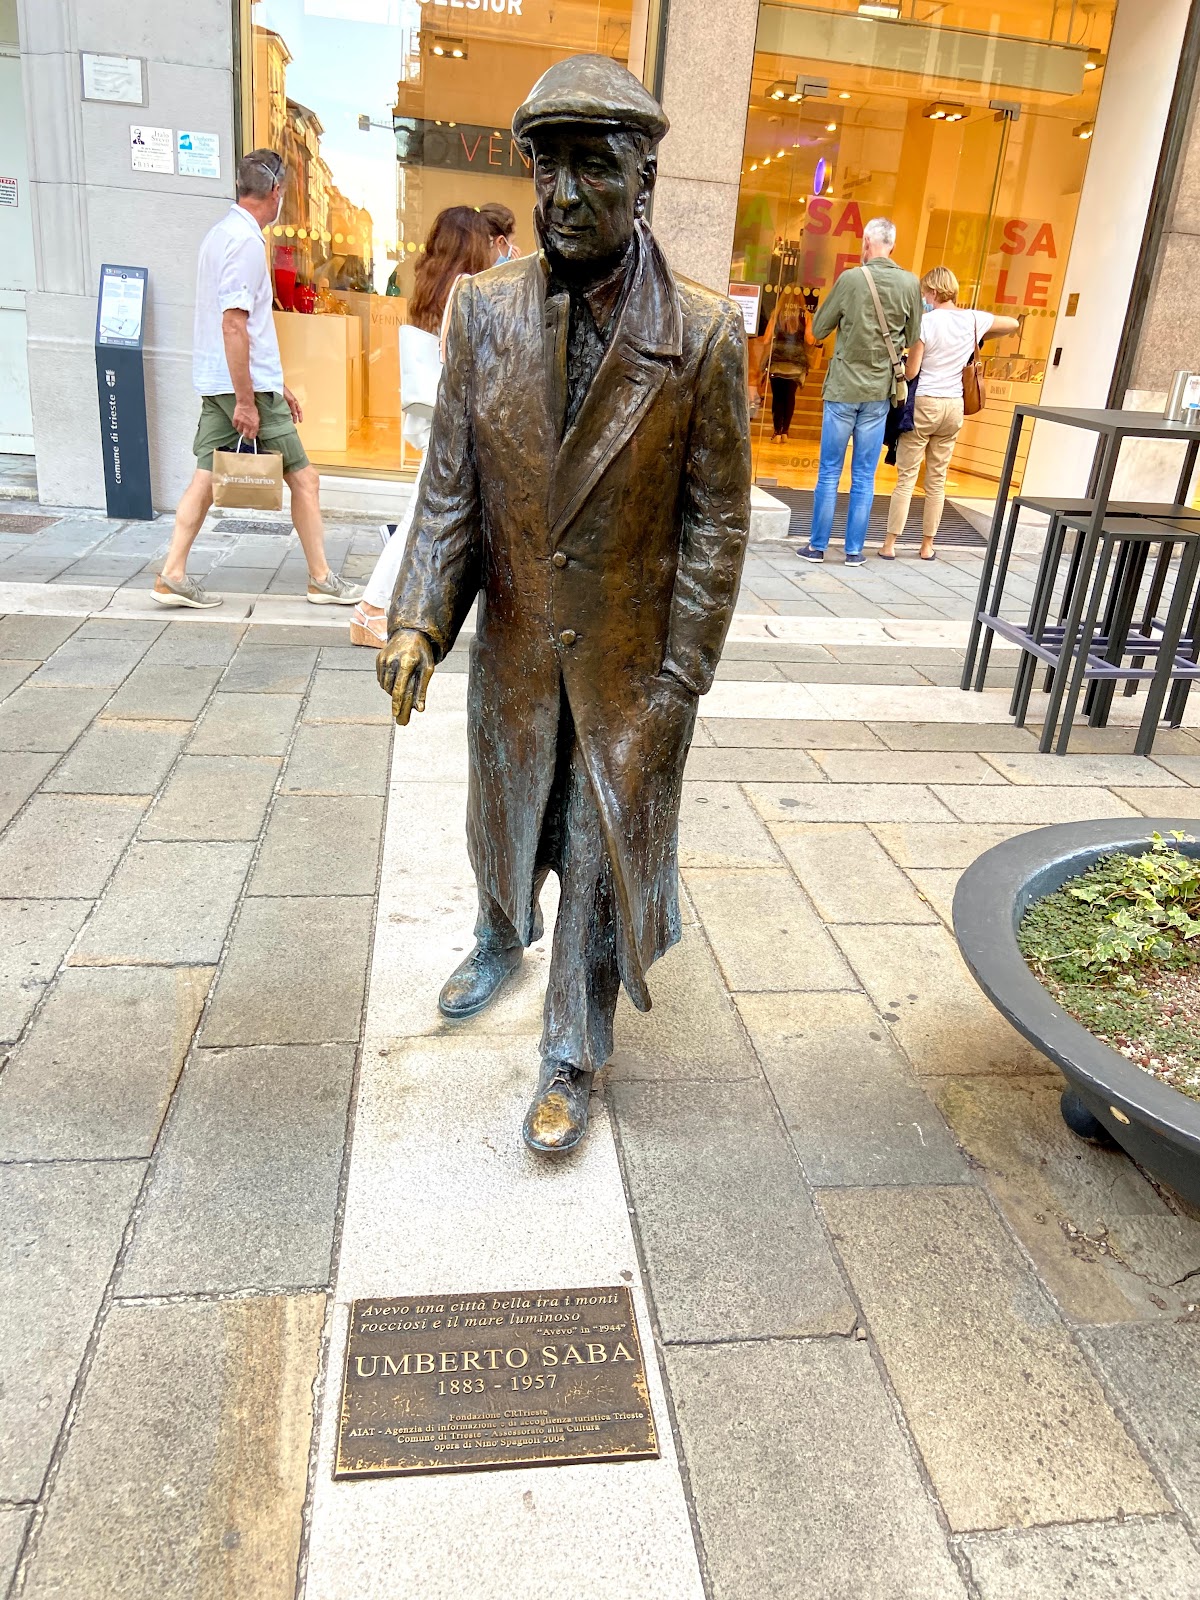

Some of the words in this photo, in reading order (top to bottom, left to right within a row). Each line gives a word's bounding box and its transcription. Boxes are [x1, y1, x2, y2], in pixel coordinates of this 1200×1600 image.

[804, 198, 864, 238] SA
[1000, 219, 1057, 258] SA
[995, 269, 1052, 307] LE
[108, 394, 118, 430] trieste
[110, 432, 119, 443] di
[113, 446, 122, 484] comune
[361, 1305, 410, 1317] Avevo
[416, 1304, 445, 1314] una
[450, 1299, 486, 1312] città
[492, 1298, 531, 1310] bella
[537, 1295, 559, 1307] tra
[565, 1296, 571, 1306] i
[576, 1293, 618, 1305] monti
[360, 1319, 428, 1333] rocciosi
[432, 1320, 441, 1329] e
[447, 1316, 459, 1328] il
[464, 1316, 504, 1327] mare
[509, 1312, 581, 1325] luminoso
[581, 1326, 590, 1334] in
[354, 1347, 528, 1377] UMBERTO
[542, 1342, 636, 1366] SABA
[438, 1378, 485, 1396] 1883
[511, 1374, 557, 1391] 1957
[349, 1427, 376, 1437] AIAT
[384, 1426, 422, 1436] Agenzia
[425, 1424, 434, 1432] di
[438, 1422, 497, 1432] informazione
[520, 1417, 572, 1428] accoglienza
[574, 1414, 611, 1423] turistica
[613, 1412, 644, 1420] Trieste
[449, 1412, 501, 1422] Fondazione
[504, 1409, 548, 1418] CRTrieste
[397, 1435, 435, 1443] Comune
[438, 1433, 447, 1441] di
[450, 1432, 482, 1440] Trieste
[491, 1428, 545, 1437] Assessorato
[547, 1426, 564, 1434] alla
[566, 1423, 600, 1432] Cultura
[434, 1443, 460, 1452] opera
[462, 1440, 472, 1449] di
[500, 1437, 540, 1448] Spagnoli
[542, 1435, 566, 1443] 2004
